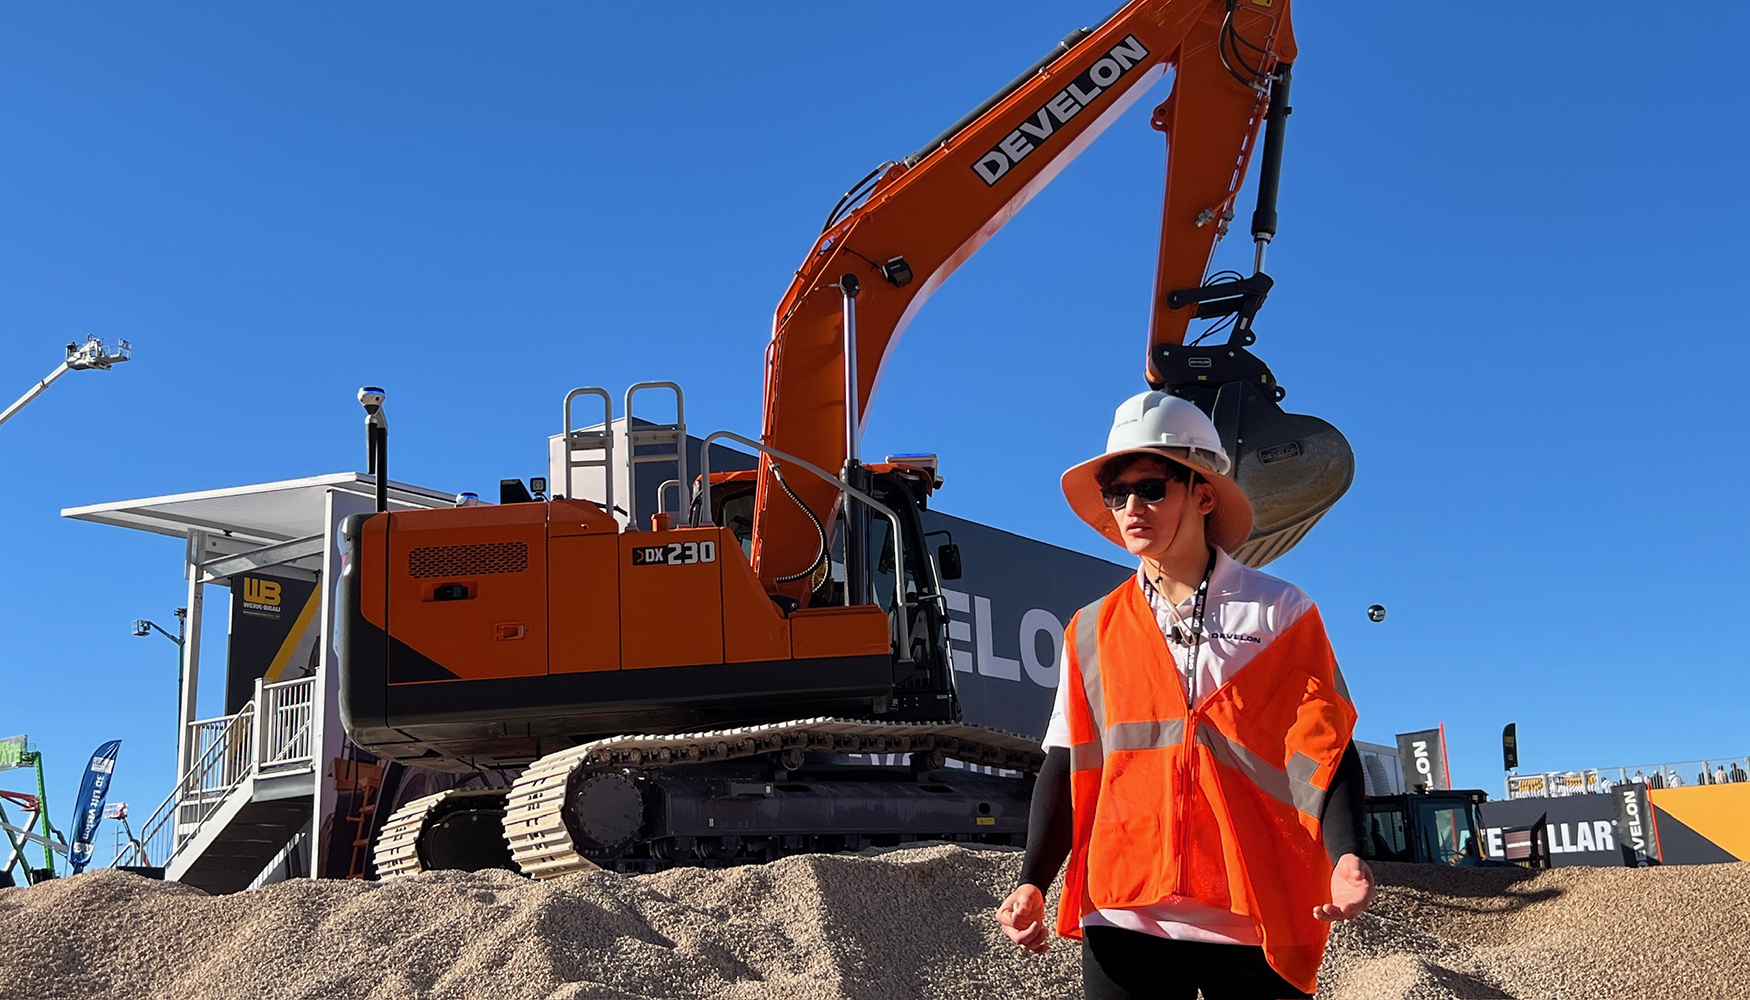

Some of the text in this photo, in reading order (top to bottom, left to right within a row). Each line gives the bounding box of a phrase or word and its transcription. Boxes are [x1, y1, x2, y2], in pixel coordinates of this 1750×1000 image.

[973, 35, 1148, 185] DEVELON
[645, 541, 716, 565] DX 230
[941, 588, 1064, 688] ELO
[1211, 632, 1261, 643] DEVELON
[0, 749, 20, 767] ATE
[1623, 790, 1649, 867] DEVELON
